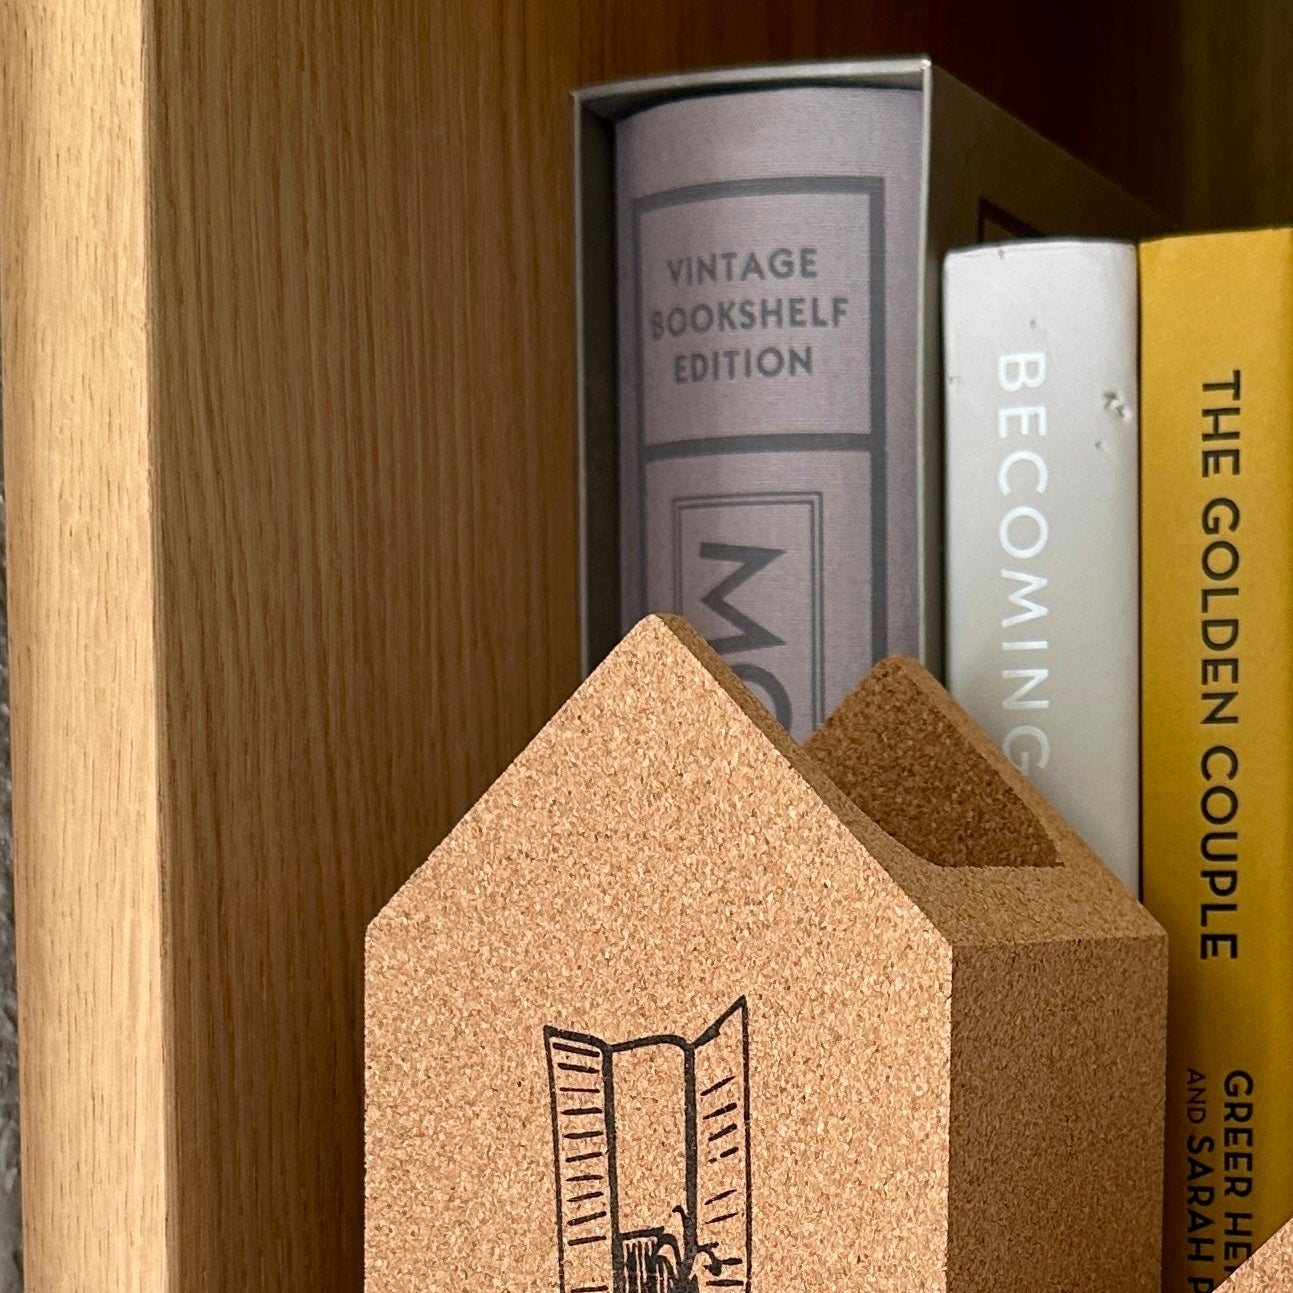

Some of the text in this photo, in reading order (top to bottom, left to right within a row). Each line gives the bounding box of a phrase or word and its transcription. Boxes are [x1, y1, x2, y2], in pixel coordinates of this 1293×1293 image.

[667, 247, 818, 283] VINTAGE
[651, 297, 849, 341] BOOKSHELF
[674, 346, 814, 385] EDITION
[998, 351, 1051, 774] BECOMING
[1199, 369, 1242, 961] THE GOLDEN COUPLE
[1186, 1068, 1207, 1125] AND
[1186, 1134, 1216, 1263] SARAH
[1222, 1069, 1254, 1276] GREER HE
